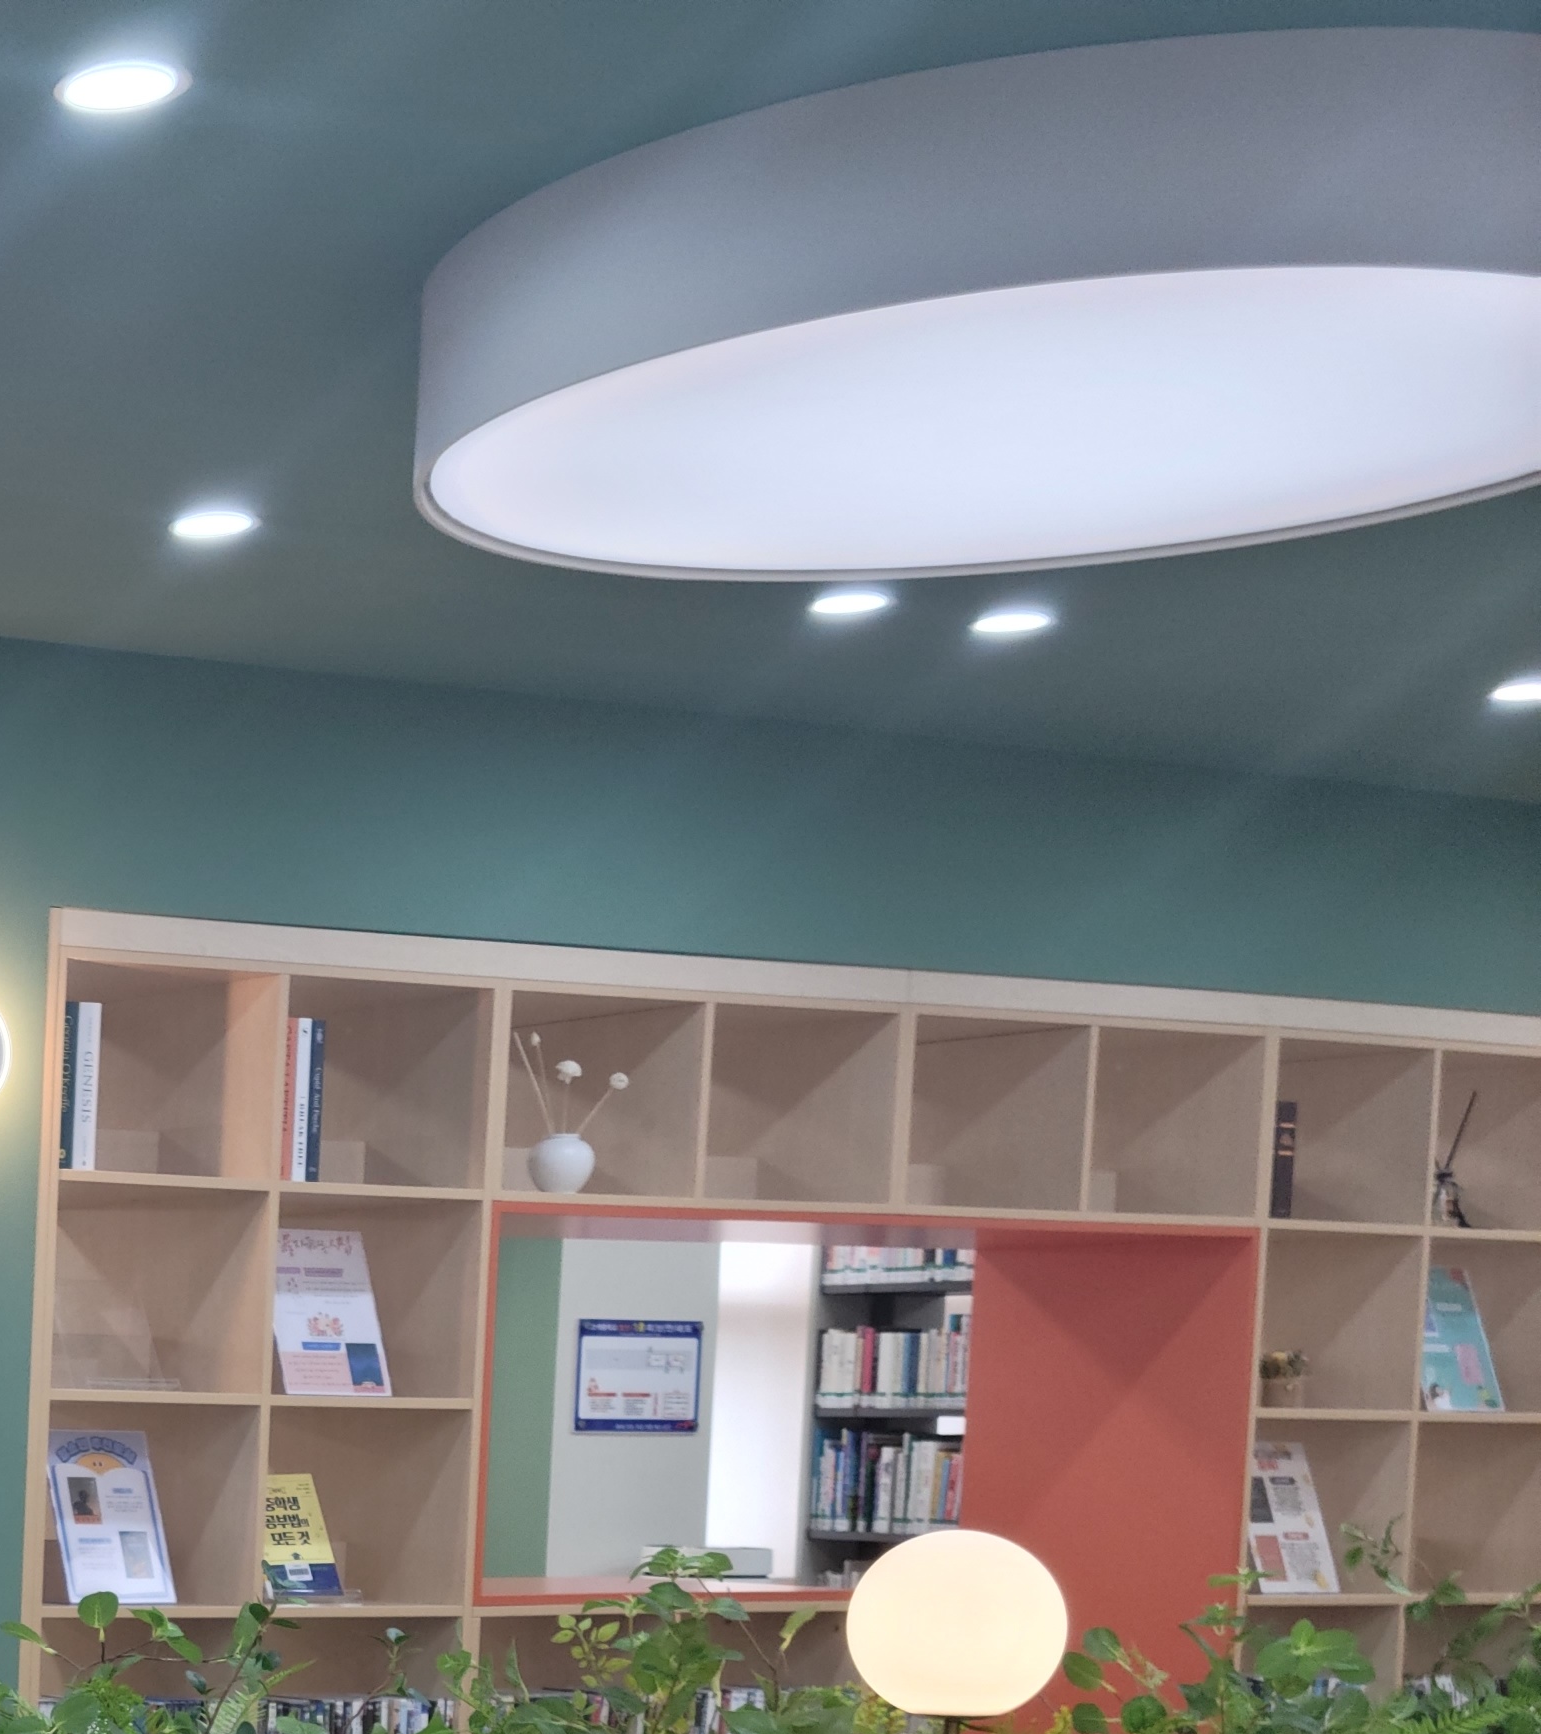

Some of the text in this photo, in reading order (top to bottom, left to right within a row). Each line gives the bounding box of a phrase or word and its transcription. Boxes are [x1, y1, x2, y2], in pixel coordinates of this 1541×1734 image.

[81, 1051, 95, 1123] GENESIS
[271, 1530, 312, 1546] 모든 것
